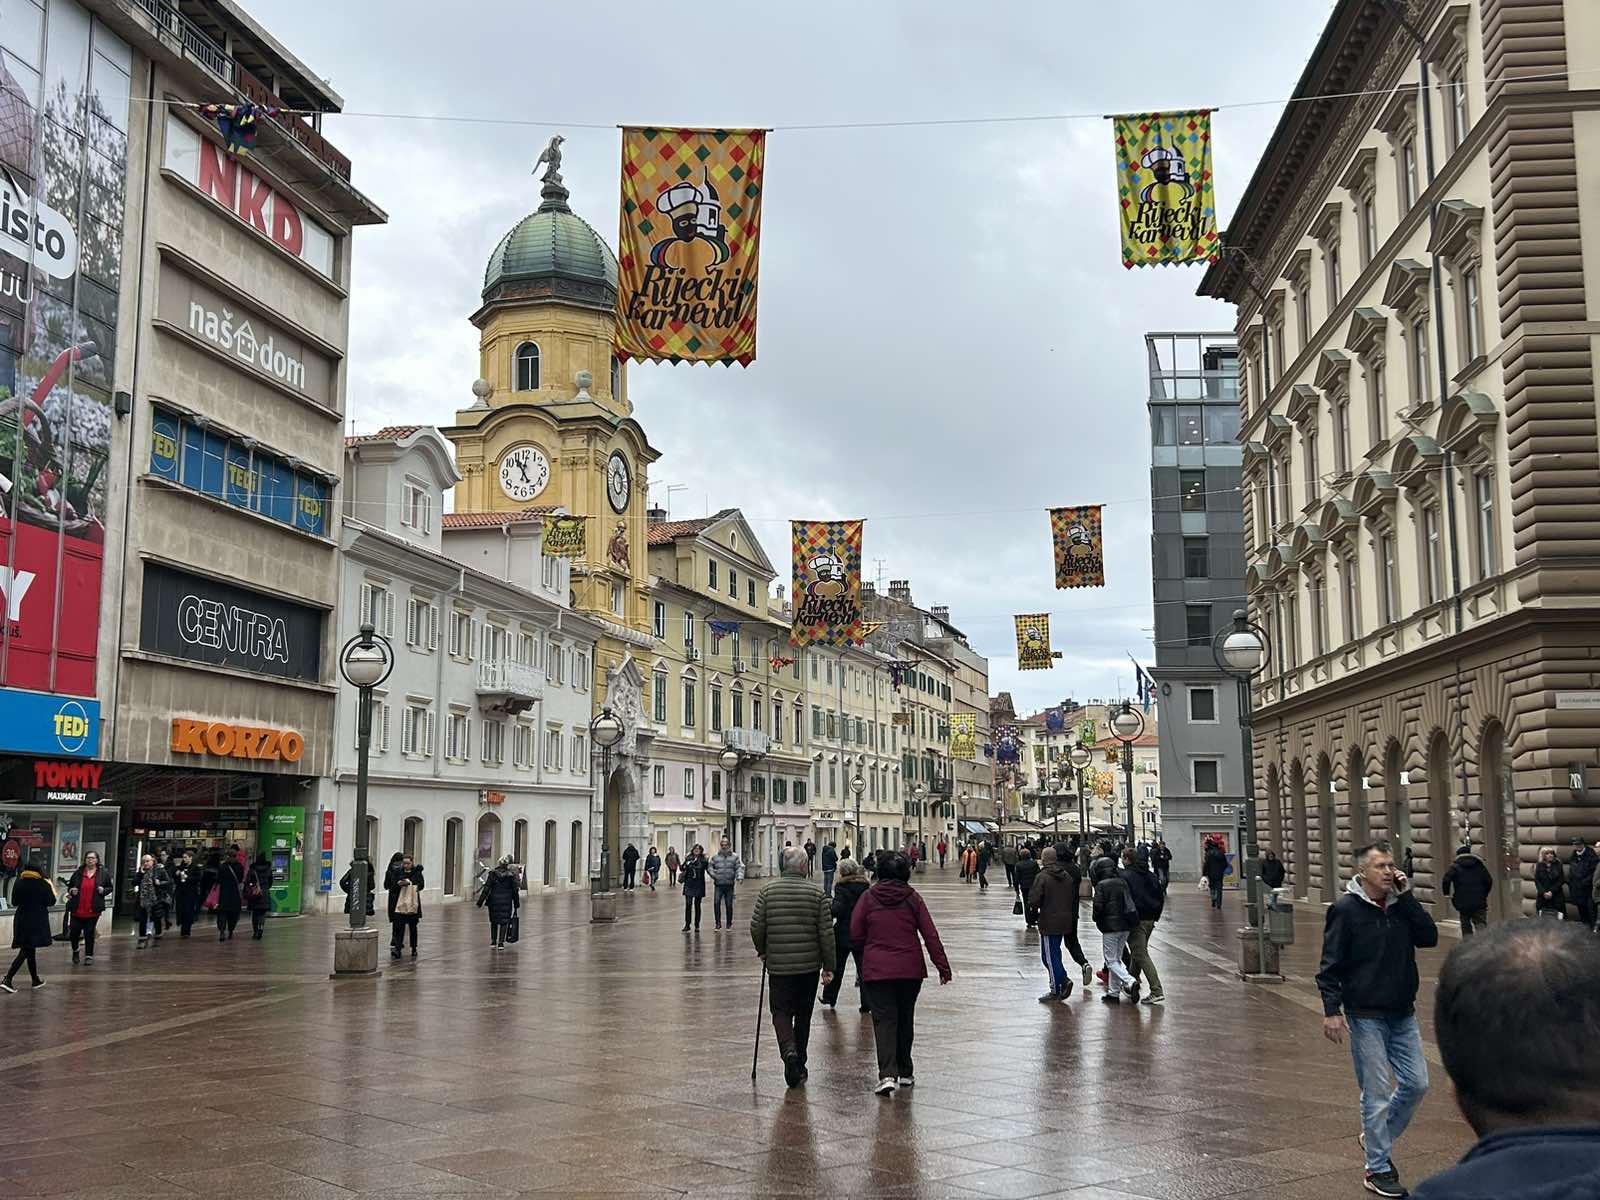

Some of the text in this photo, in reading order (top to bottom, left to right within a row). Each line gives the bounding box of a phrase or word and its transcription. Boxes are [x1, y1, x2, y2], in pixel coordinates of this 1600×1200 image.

[199, 137, 303, 257] NKD
[190, 301, 304, 389] naš dom
[522, 450, 531, 460] 12
[533, 452, 537, 462] 1
[506, 458, 514, 468] 10
[537, 456, 543, 466] 2
[502, 469, 509, 479] 9
[540, 467, 547, 478] 3
[505, 479, 512, 490] 8
[536, 477, 543, 487] 4
[513, 486, 519, 496] 7
[521, 486, 528, 497] 6
[529, 484, 536, 495] 5
[178, 595, 289, 664] CENTRA
[53, 715, 89, 738] TEDi
[172, 718, 304, 762] KORZO
[34, 761, 104, 789] TOMMY
[47, 791, 87, 801] MAXIMARKET
